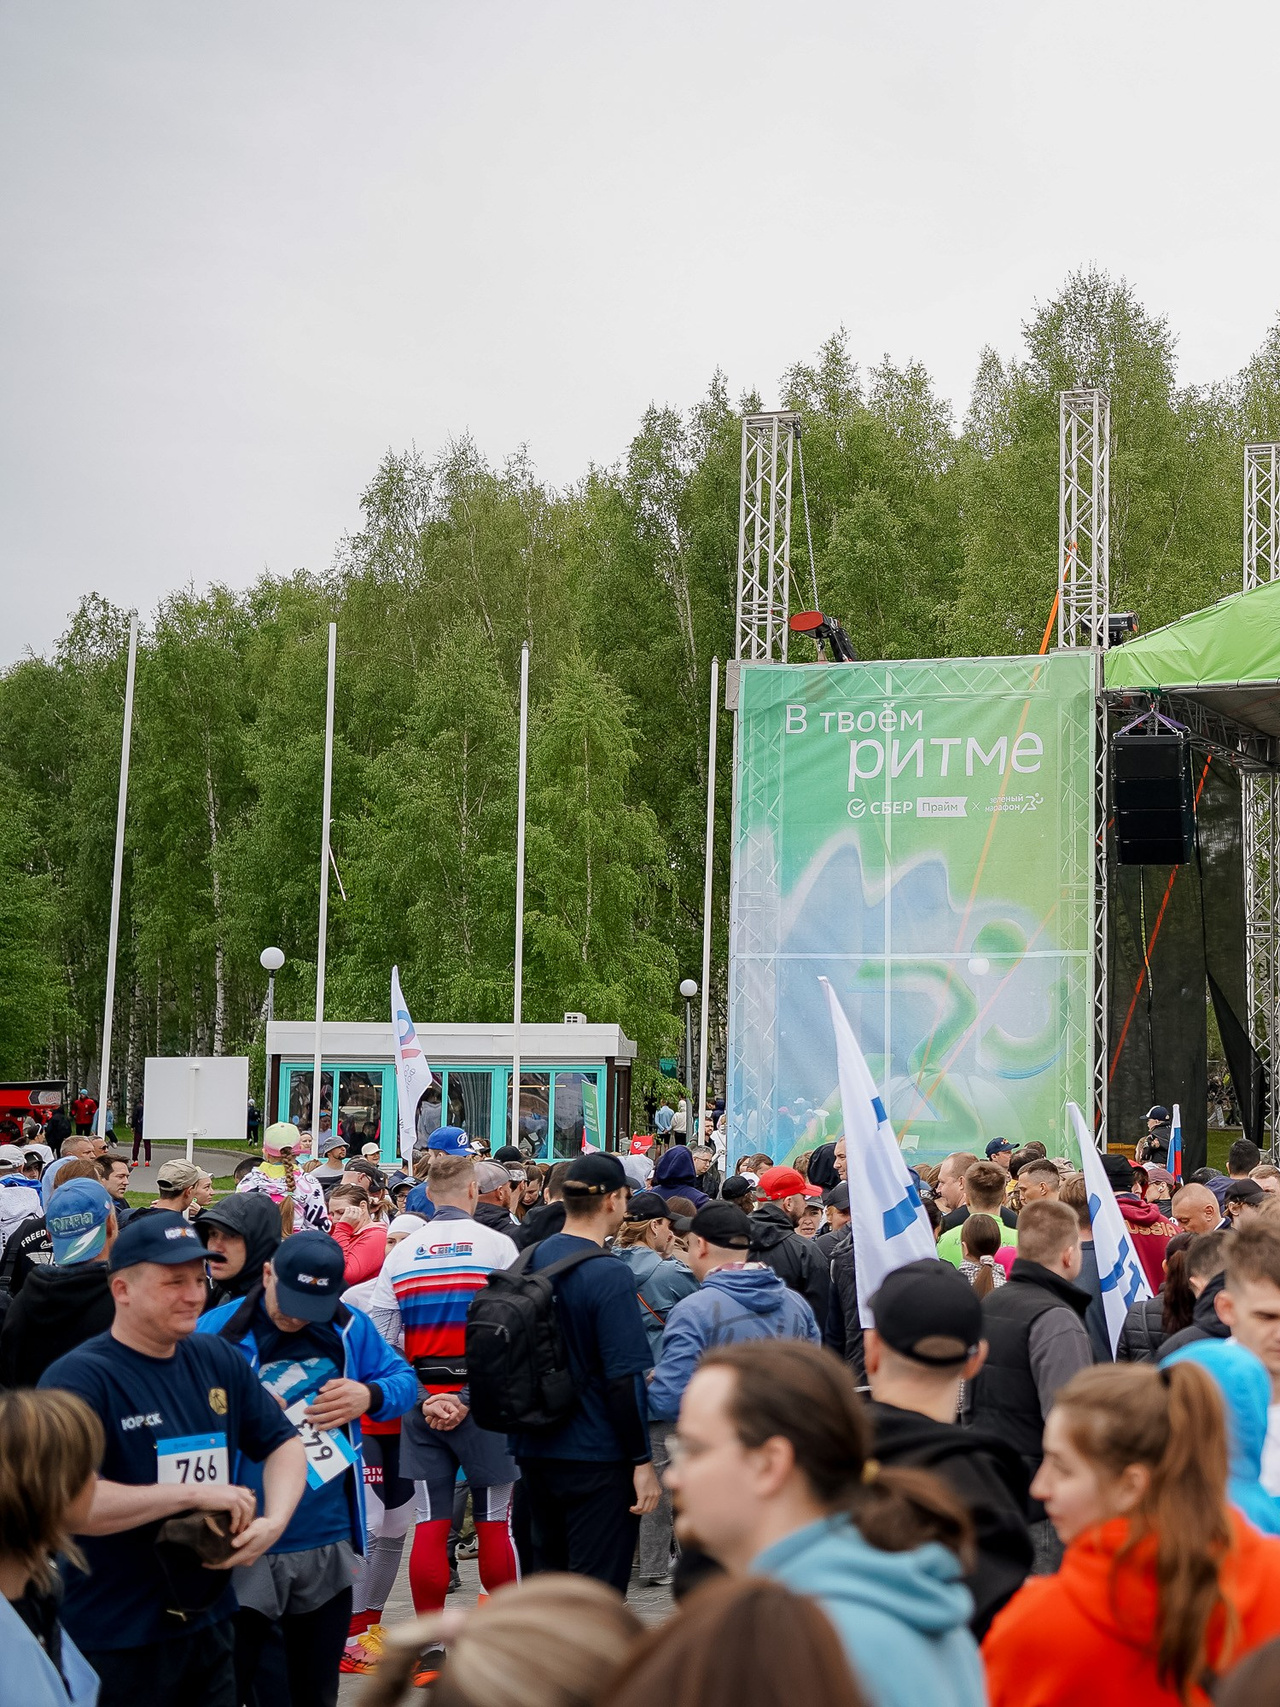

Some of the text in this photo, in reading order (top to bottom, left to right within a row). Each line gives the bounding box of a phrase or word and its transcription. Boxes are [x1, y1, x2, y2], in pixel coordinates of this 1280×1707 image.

[785, 702, 923, 734] В твоём
[848, 732, 1044, 792] ритме
[989, 793, 1024, 803] зелёный
[870, 801, 958, 815] СБЕР Прайм
[984, 803, 1021, 813] марафон
[1123, 1219, 1178, 1238] USSIA
[20, 1229, 50, 1248] FREED
[175, 1454, 218, 1484] 766
